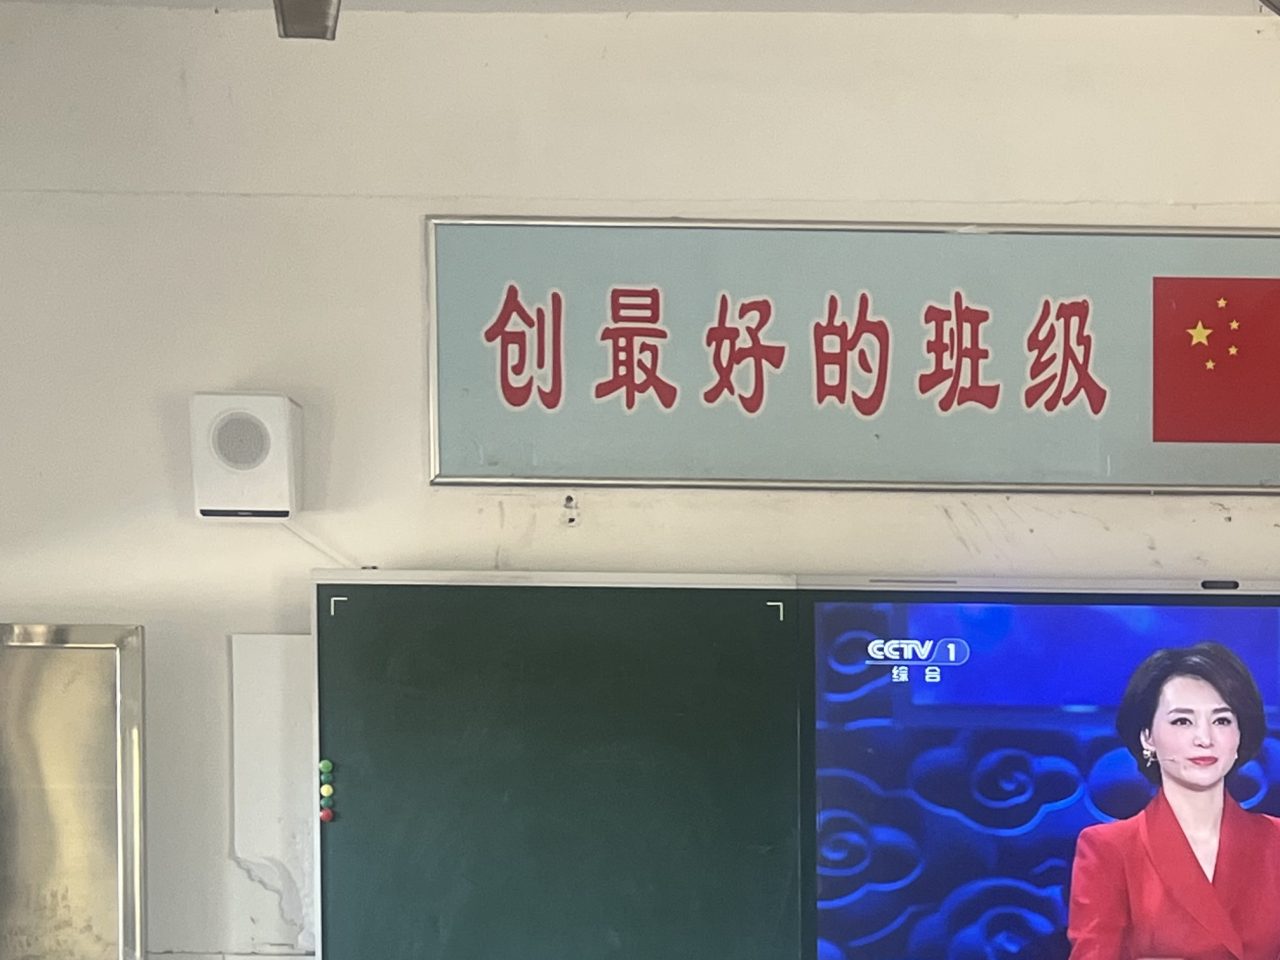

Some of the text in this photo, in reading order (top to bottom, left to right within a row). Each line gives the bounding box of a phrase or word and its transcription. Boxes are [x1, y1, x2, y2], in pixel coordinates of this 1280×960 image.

[484, 284, 1109, 416] 创最好的班级
[867, 639, 956, 661] CCTV 1
